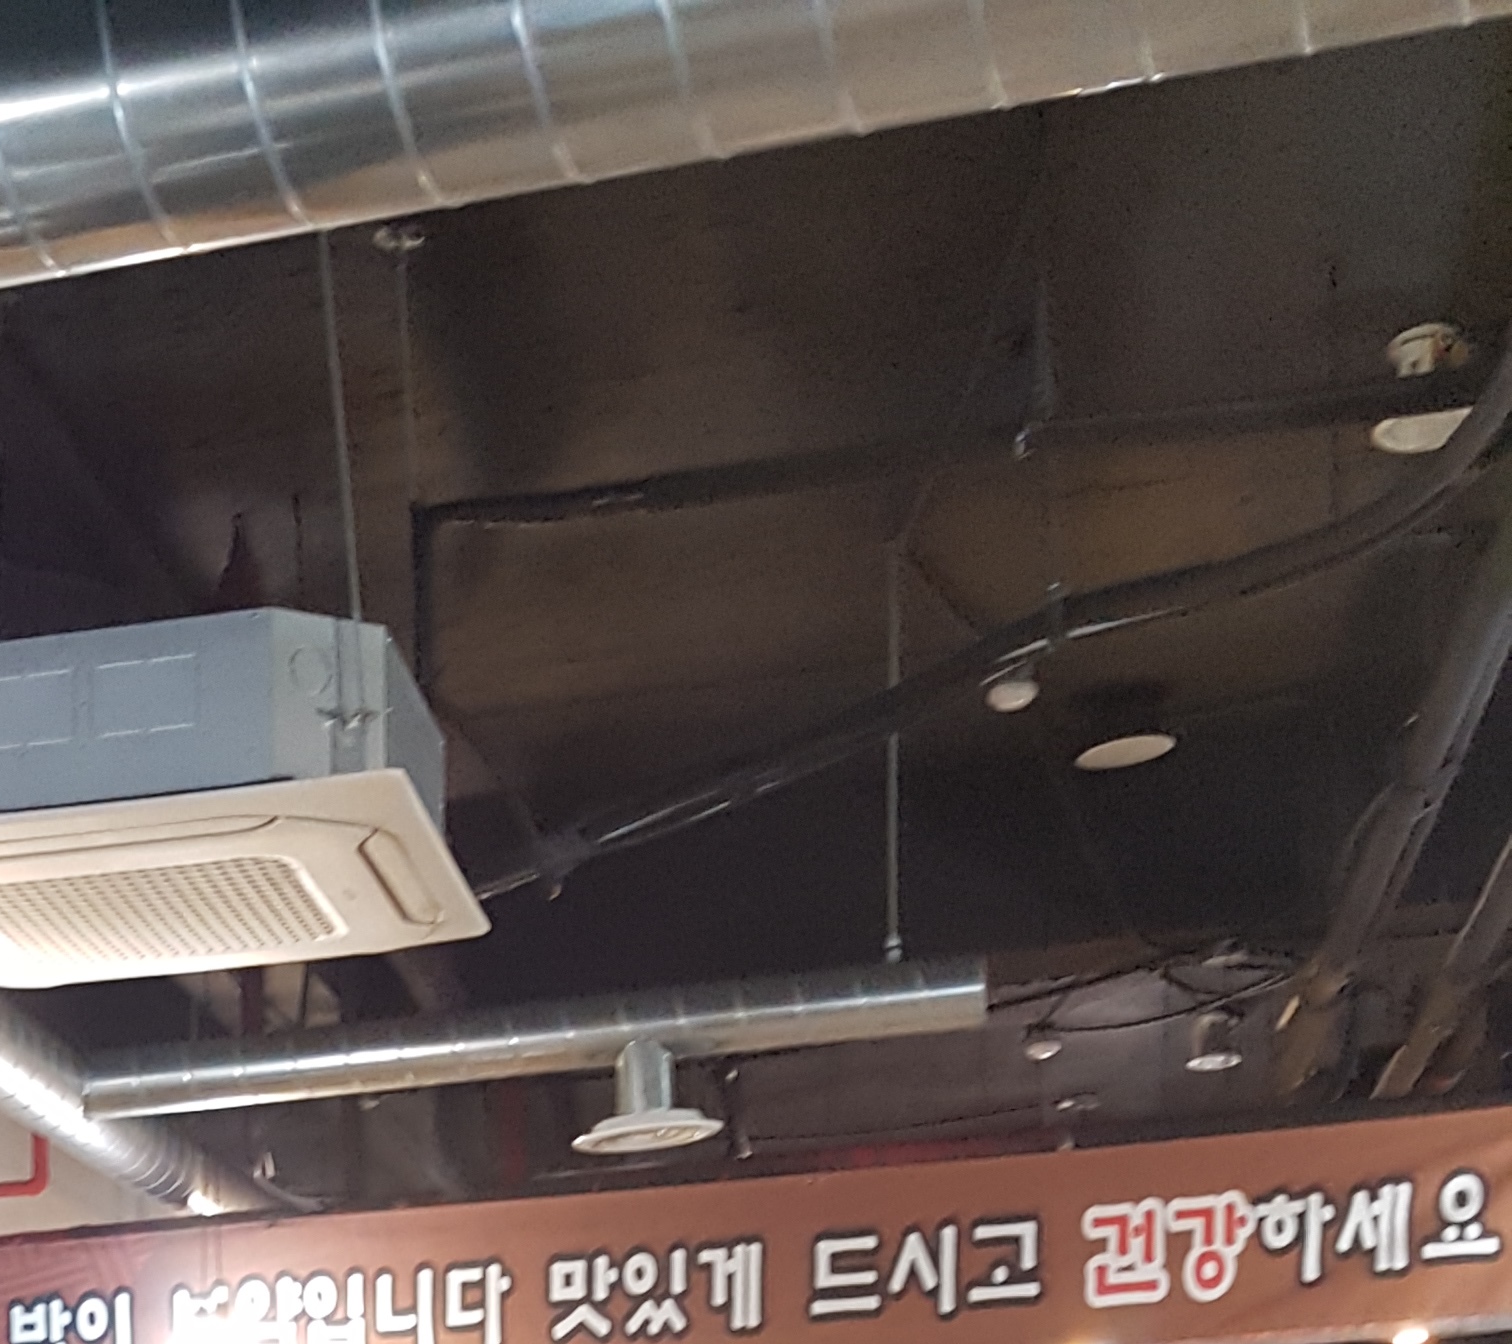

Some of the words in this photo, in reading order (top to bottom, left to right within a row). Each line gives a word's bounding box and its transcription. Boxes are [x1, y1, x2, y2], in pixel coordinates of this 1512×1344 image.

[547, 1240, 764, 1342] 맛있게
[808, 1218, 1042, 1317] 드시고
[1082, 1171, 1502, 1308] 건강하세요
